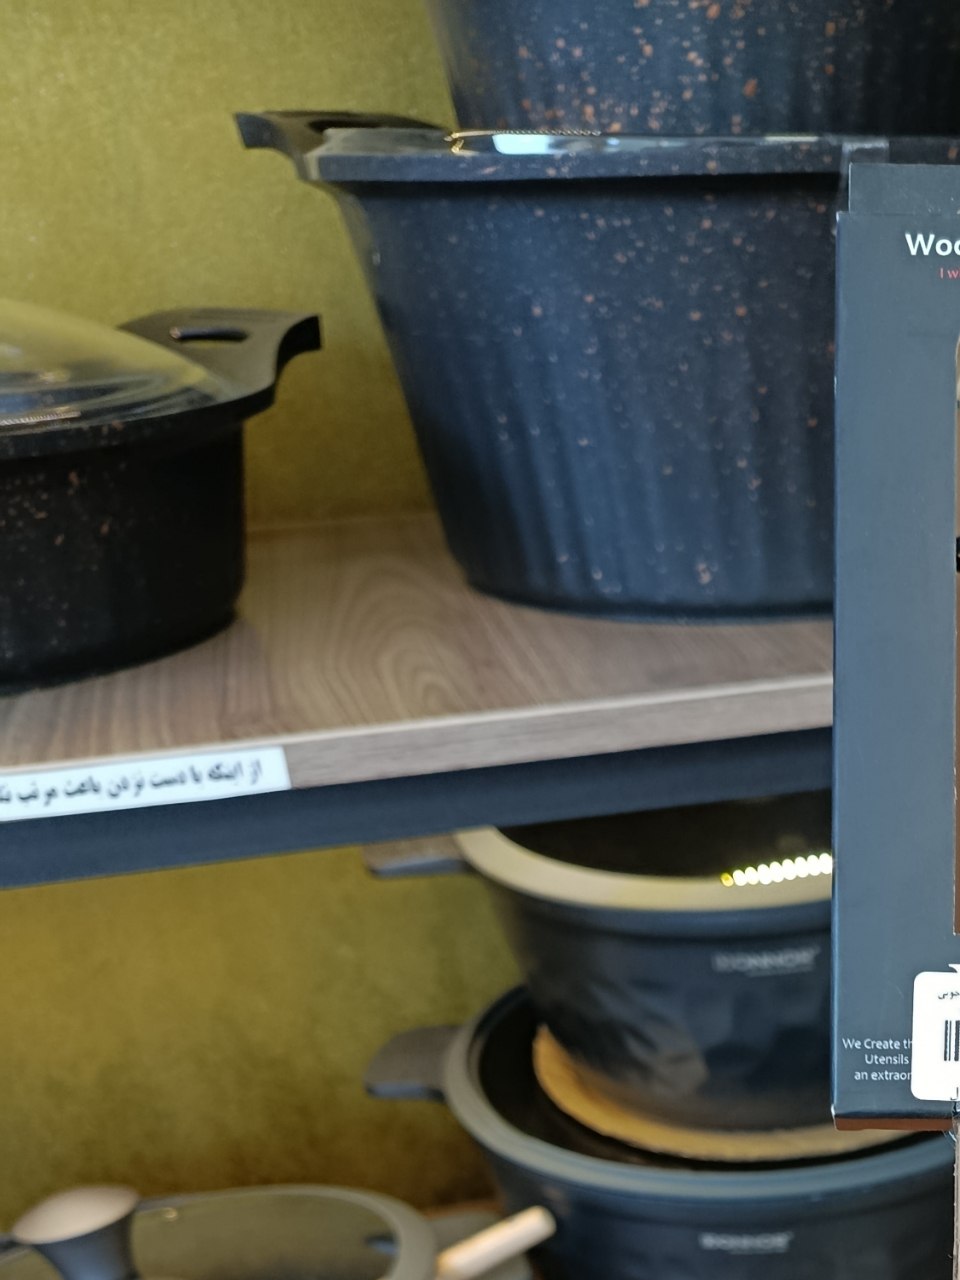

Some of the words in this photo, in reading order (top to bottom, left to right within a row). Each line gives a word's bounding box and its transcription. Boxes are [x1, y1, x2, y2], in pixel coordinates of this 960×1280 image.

[940, 268, 944, 279] I
[842, 1037, 861, 1050] We
[864, 1037, 900, 1050] Create
[903, 1038, 913, 1050] th
[864, 1053, 909, 1065] Utensils
[854, 1071, 868, 1081] an
[871, 1069, 912, 1081] extraor
